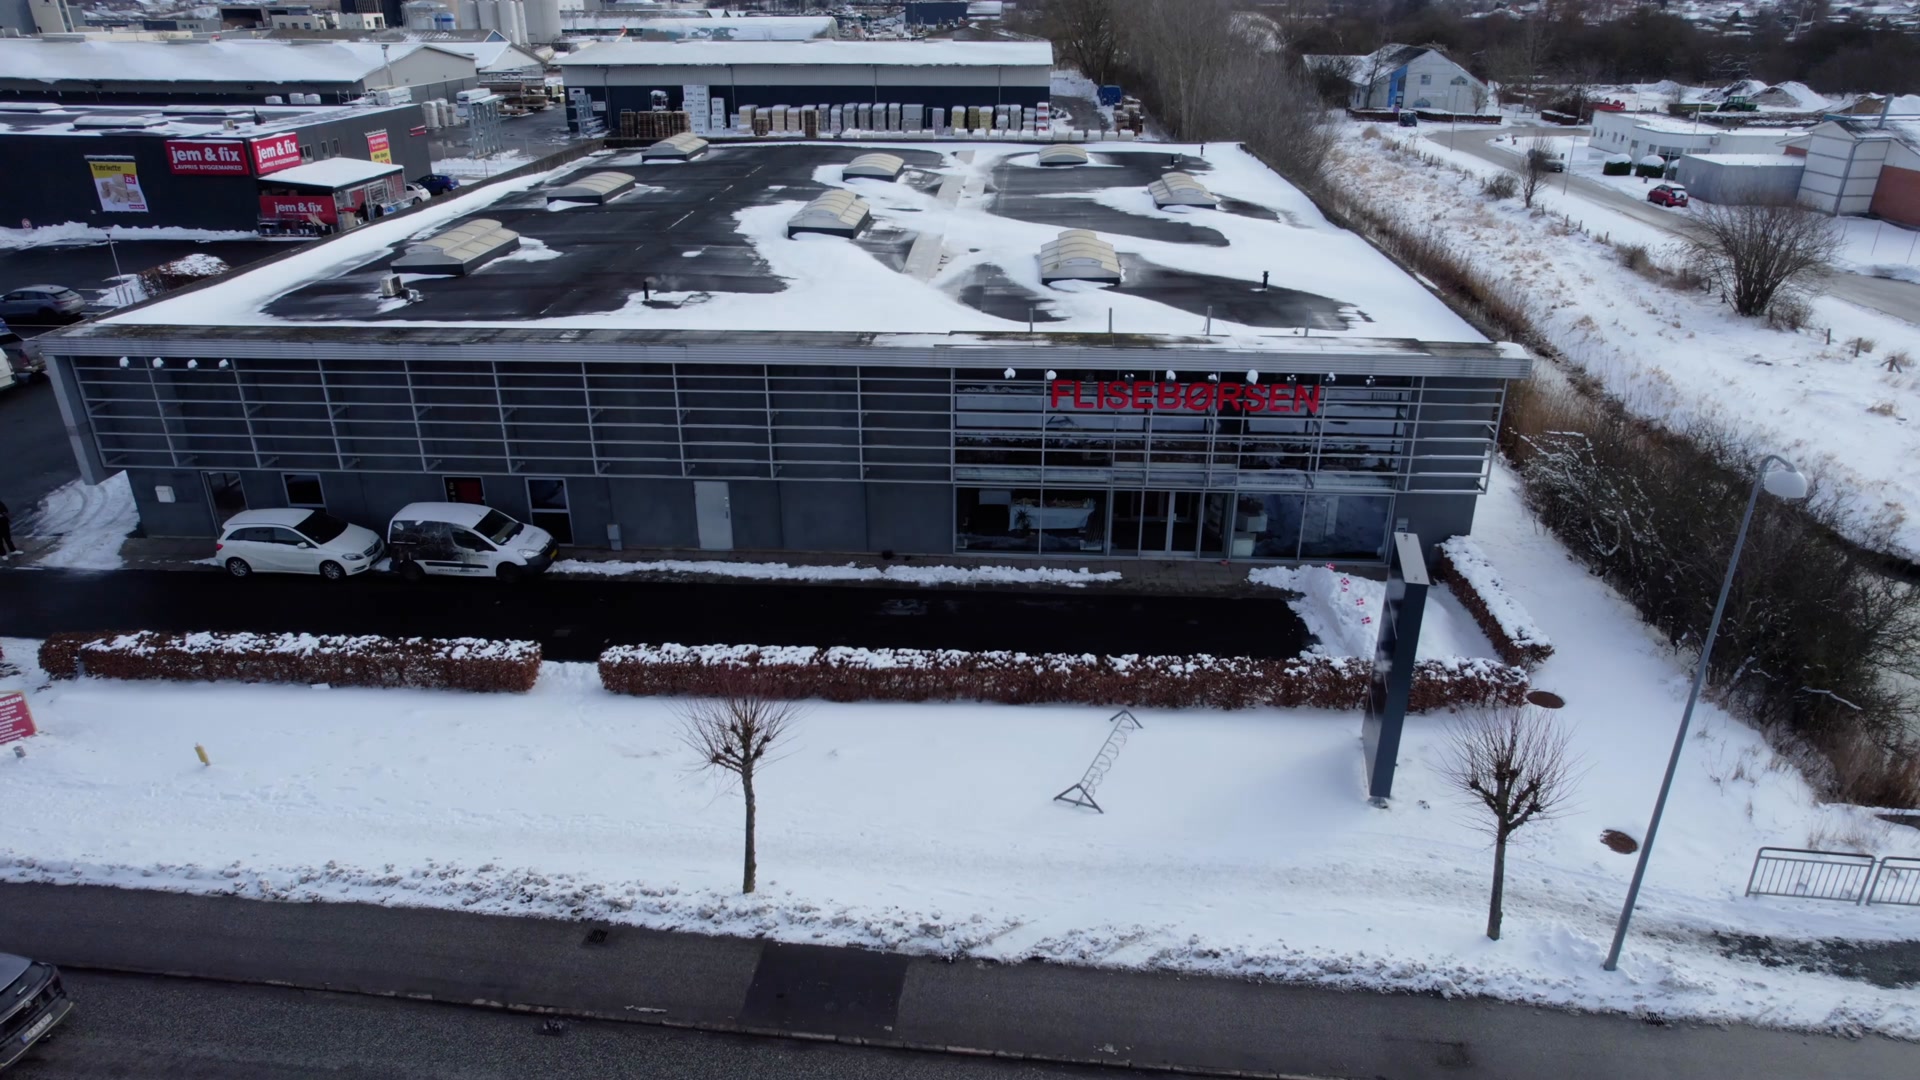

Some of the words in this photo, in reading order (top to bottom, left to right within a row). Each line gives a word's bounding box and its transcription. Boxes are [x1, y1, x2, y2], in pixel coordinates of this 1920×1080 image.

[171, 146, 202, 164] jem
[204, 147, 218, 161] &
[219, 147, 241, 162] fix
[257, 145, 276, 163] jem
[276, 142, 285, 156] &
[284, 139, 298, 154] fix
[274, 201, 296, 214] jem
[298, 202, 307, 212] &
[308, 202, 323, 213] fix
[1051, 380, 1321, 414] FLISEBØRSEN
